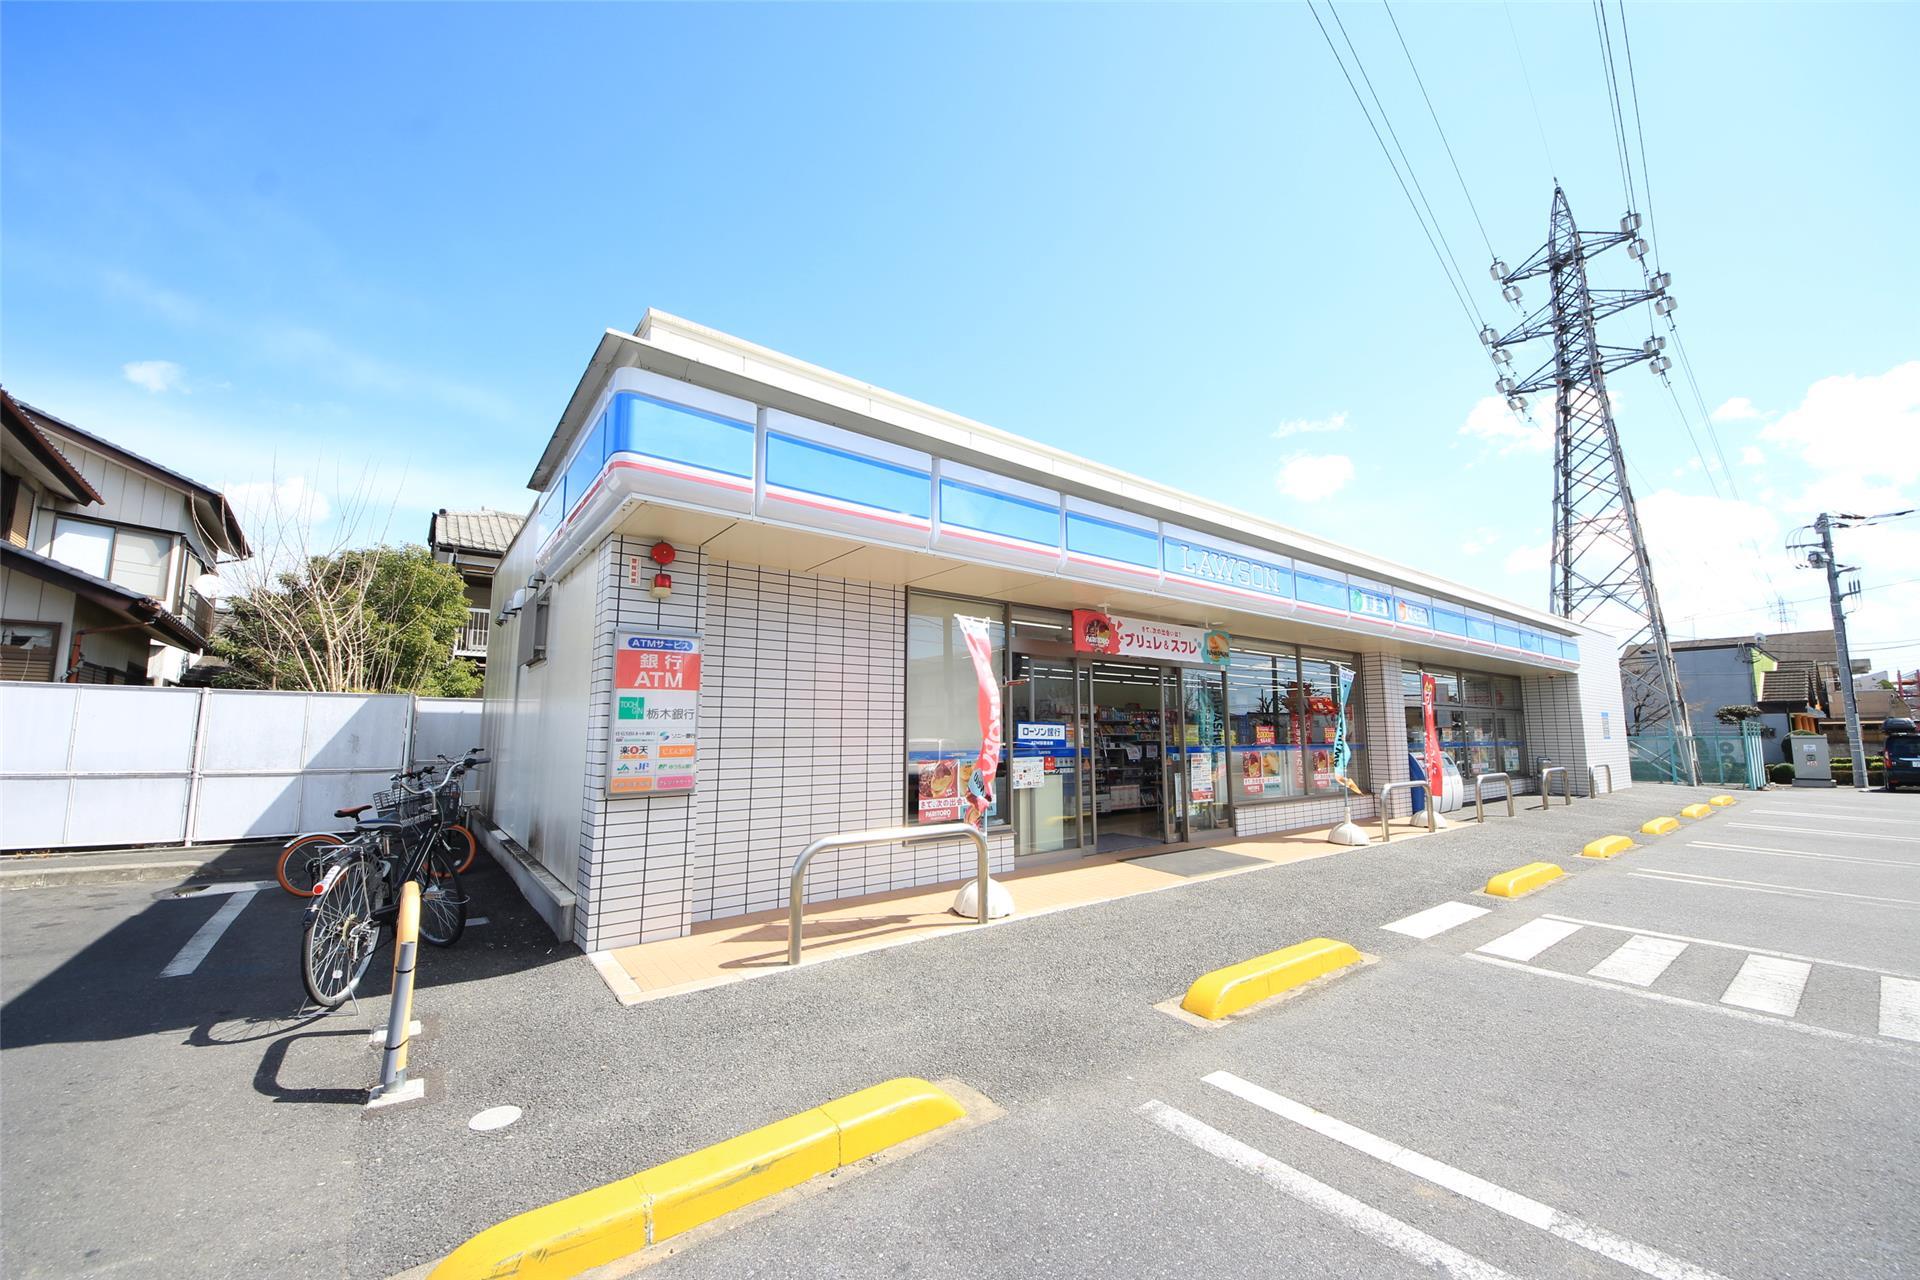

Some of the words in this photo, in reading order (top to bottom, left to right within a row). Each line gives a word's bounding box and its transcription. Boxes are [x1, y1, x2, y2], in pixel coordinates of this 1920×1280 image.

[1180, 544, 1280, 593] LAWSON
[632, 639, 690, 650] ATMサービス
[640, 653, 682, 670] 銀行
[634, 671, 683, 688] ATM
[647, 708, 695, 721] 栃木銀行
[1023, 728, 1061, 737] ローソン銀行
